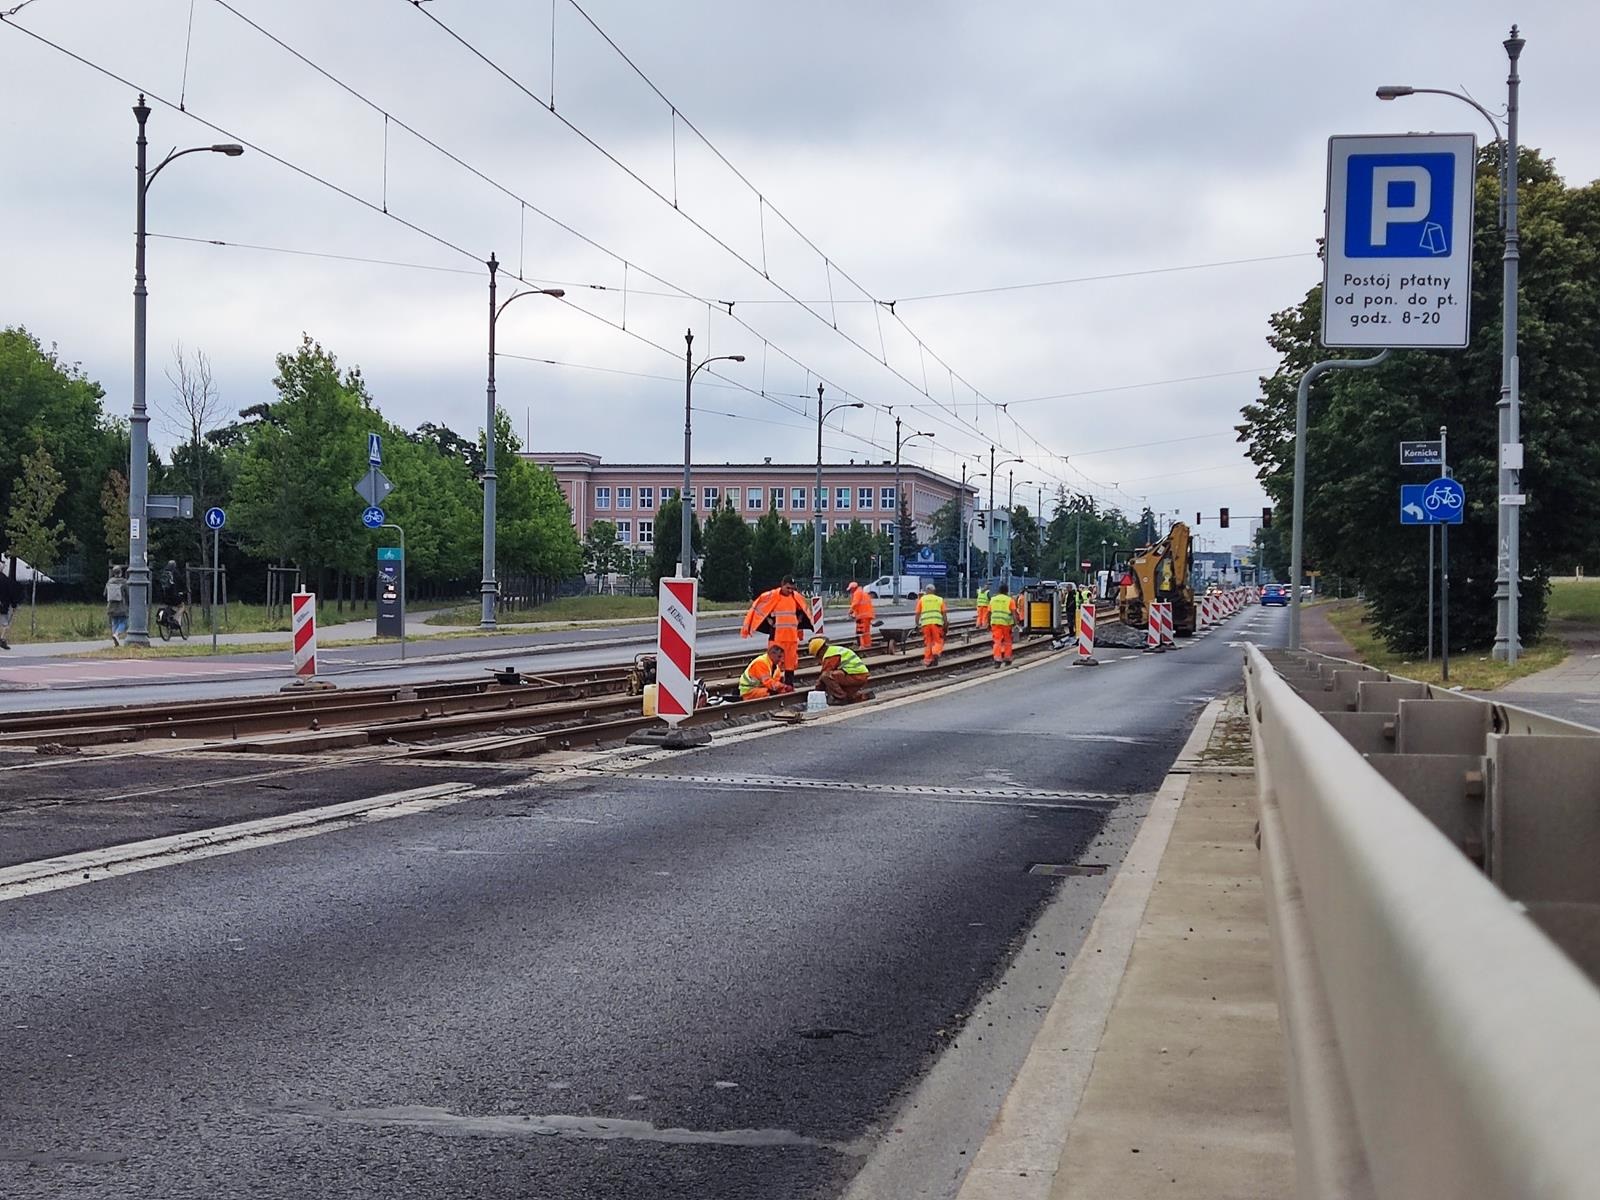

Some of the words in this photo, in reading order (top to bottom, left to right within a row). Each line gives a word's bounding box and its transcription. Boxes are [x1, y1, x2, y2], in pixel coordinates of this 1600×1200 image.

[1371, 166, 1432, 246] P
[1344, 273, 1391, 290] Postój
[1400, 274, 1451, 290] płatny
[1335, 292, 1354, 305] od
[1364, 296, 1398, 309] pon.
[1408, 292, 1427, 305] do
[1437, 293, 1458, 309] pt.
[1350, 311, 1392, 327] godz.
[1402, 311, 1441, 324] 8-20
